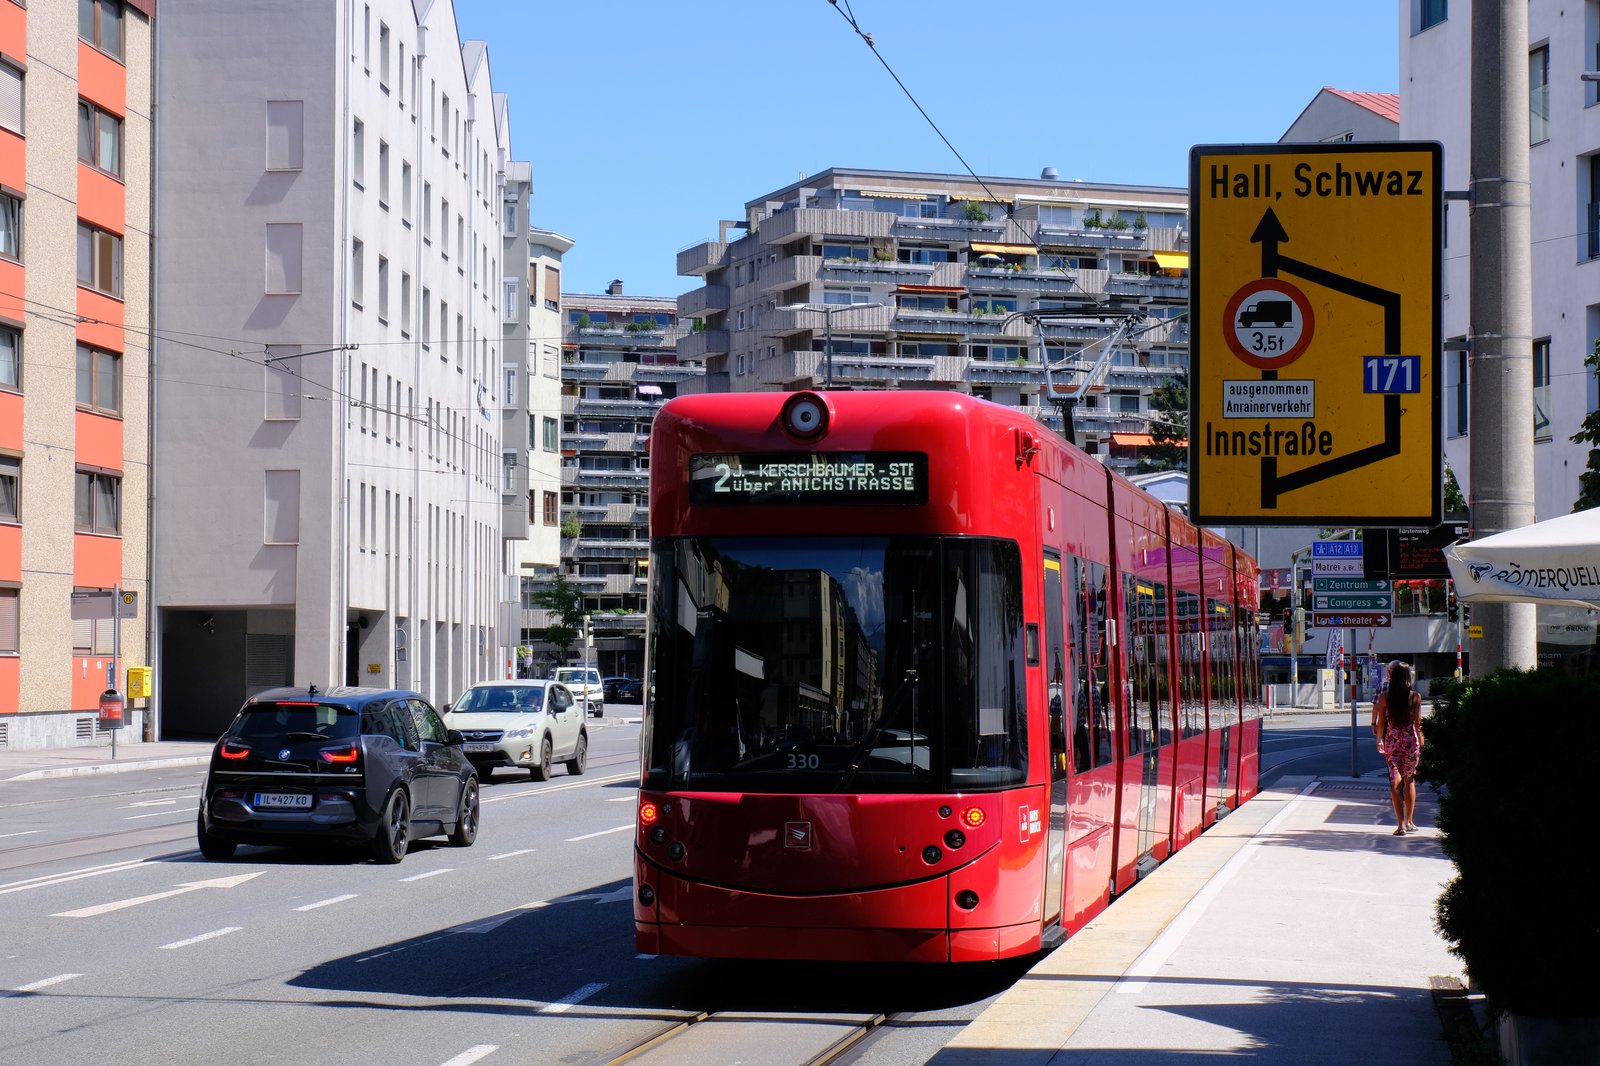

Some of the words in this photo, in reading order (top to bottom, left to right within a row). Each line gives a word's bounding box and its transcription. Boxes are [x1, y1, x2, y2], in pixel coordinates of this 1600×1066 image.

[1210, 162, 1282, 202] Hall,
[1294, 161, 1423, 197] Schwaz
[1252, 331, 1285, 353] 3,5t
[1367, 357, 1413, 391] 171
[1228, 383, 1309, 398] ausgenommen
[1226, 400, 1311, 414] Anrainerverkehr
[1206, 420, 1333, 457] Innstraße
[714, 463, 731, 493] 2
[733, 478, 773, 491] über
[781, 477, 915, 491] ANICHSTRASSE
[1329, 545, 1342, 553] A12
[1315, 562, 1340, 571] Matrei
[1329, 580, 1368, 589] Zentrum
[1330, 598, 1371, 608] Congress
[786, 753, 820, 769] 330
